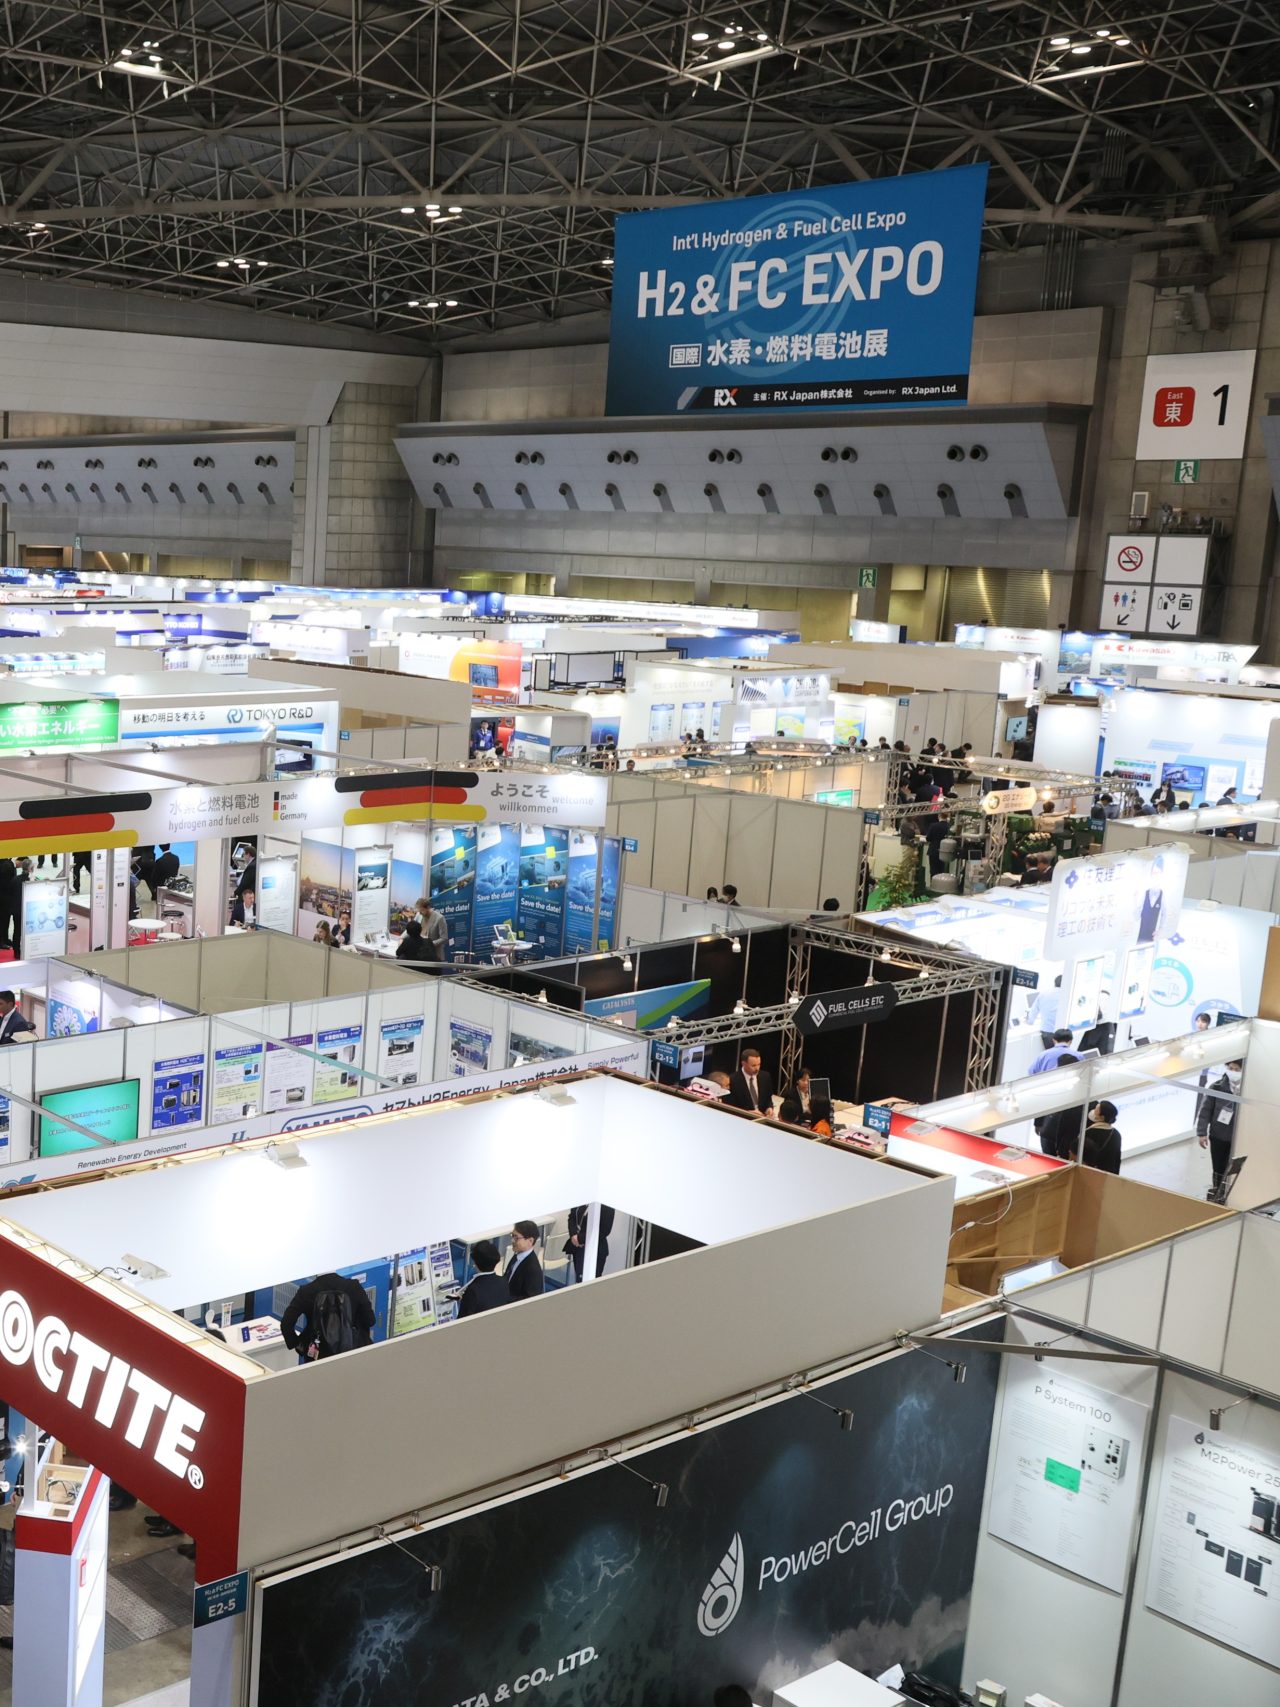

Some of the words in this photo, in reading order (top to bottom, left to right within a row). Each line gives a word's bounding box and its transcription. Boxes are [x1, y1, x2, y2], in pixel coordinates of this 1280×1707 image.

[673, 234, 699, 251] Int'l
[701, 225, 771, 248] Hydrogen
[776, 223, 788, 239] &
[794, 218, 827, 237] Fuel
[830, 213, 862, 232] Cell
[867, 211, 906, 231] Expo
[637, 269, 685, 318] H2
[690, 274, 720, 315] &
[728, 257, 788, 311] FC
[802, 240, 944, 305] EXPO
[672, 347, 699, 364] 国際
[706, 329, 888, 366] 水素・燃料電池展
[714, 388, 738, 406] RX
[773, 391, 788, 401] RX
[902, 385, 913, 395] RX
[914, 385, 941, 396] Japan
[941, 384, 957, 394] Ltd.
[1167, 391, 1183, 400] East
[1164, 402, 1182, 423] 東
[1213, 384, 1230, 426] 1
[1129, 645, 1177, 656] Kawasaki
[133, 711, 206, 724] 移動の明日を考える
[246, 708, 287, 721] TOKYO
[289, 707, 313, 719] R&D
[280, 791, 298, 801] made
[490, 783, 550, 799] ようこそ
[169, 793, 260, 815] 水素と燃料電池
[280, 802, 286, 810] in
[499, 801, 558, 814] willkommen
[552, 794, 594, 806] welcome
[169, 820, 207, 833] hydrogen
[209, 818, 223, 828] and
[225, 816, 240, 826] fuel
[242, 813, 259, 824] cells
[280, 811, 307, 821] Germany
[477, 892, 491, 902] Save
[492, 891, 502, 901] the
[503, 889, 515, 900] date!
[445, 904, 454, 913] the
[455, 902, 470, 913] date!
[520, 897, 535, 907] Save
[536, 900, 545, 910] the
[546, 902, 561, 914] date!
[569, 901, 583, 911] Save
[584, 904, 595, 913] the
[828, 1001, 847, 1013] FUEL
[848, 997, 870, 1011] CELLS
[871, 995, 885, 1006] ETC
[588, 1057, 609, 1070] Simply
[611, 1052, 639, 1067] Powerful
[655, 1052, 674, 1065] E2-12
[77, 1154, 116, 1170] Renewable
[118, 1150, 143, 1164] Energy
[143, 1142, 188, 1158] Development
[1035, 1385, 1043, 1395] P
[1044, 1388, 1087, 1416] System
[1089, 1405, 1112, 1424] 100
[1200, 1447, 1262, 1481] M2Power
[758, 1508, 882, 1591] PowerCell
[885, 1484, 954, 1532] Group
[224, 1580, 240, 1590] EXPO
[209, 1598, 236, 1618] E2-5
[494, 1682, 511, 1702] &
[515, 1665, 556, 1692] CO.,
[558, 1645, 600, 1676] LTD.
